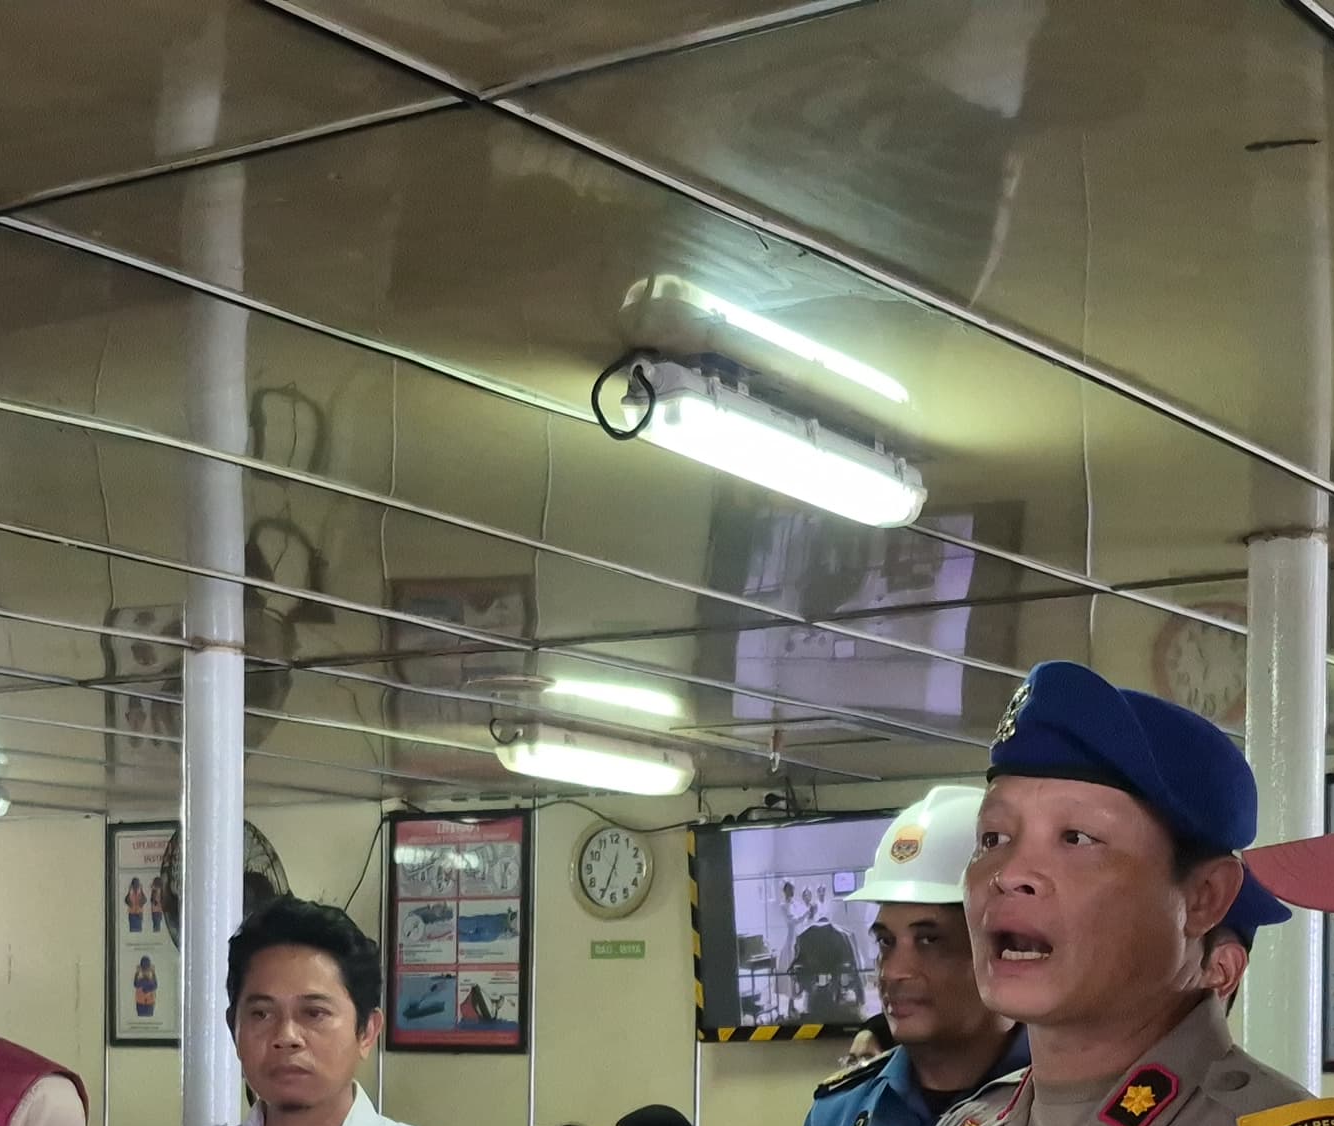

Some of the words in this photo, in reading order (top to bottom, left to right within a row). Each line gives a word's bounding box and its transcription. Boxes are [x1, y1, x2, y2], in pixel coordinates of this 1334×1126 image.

[599, 838, 607, 849] 11
[610, 833, 620, 844] 12
[625, 838, 630, 848] 1
[590, 851, 601, 862] 10
[633, 847, 639, 859] 2
[586, 864, 593, 875] 9
[636, 862, 643, 874] 3
[589, 877, 596, 888] 8
[631, 877, 638, 887] 4
[599, 888, 606, 899] 7
[610, 892, 617, 903] 6
[622, 887, 629, 899] 5
